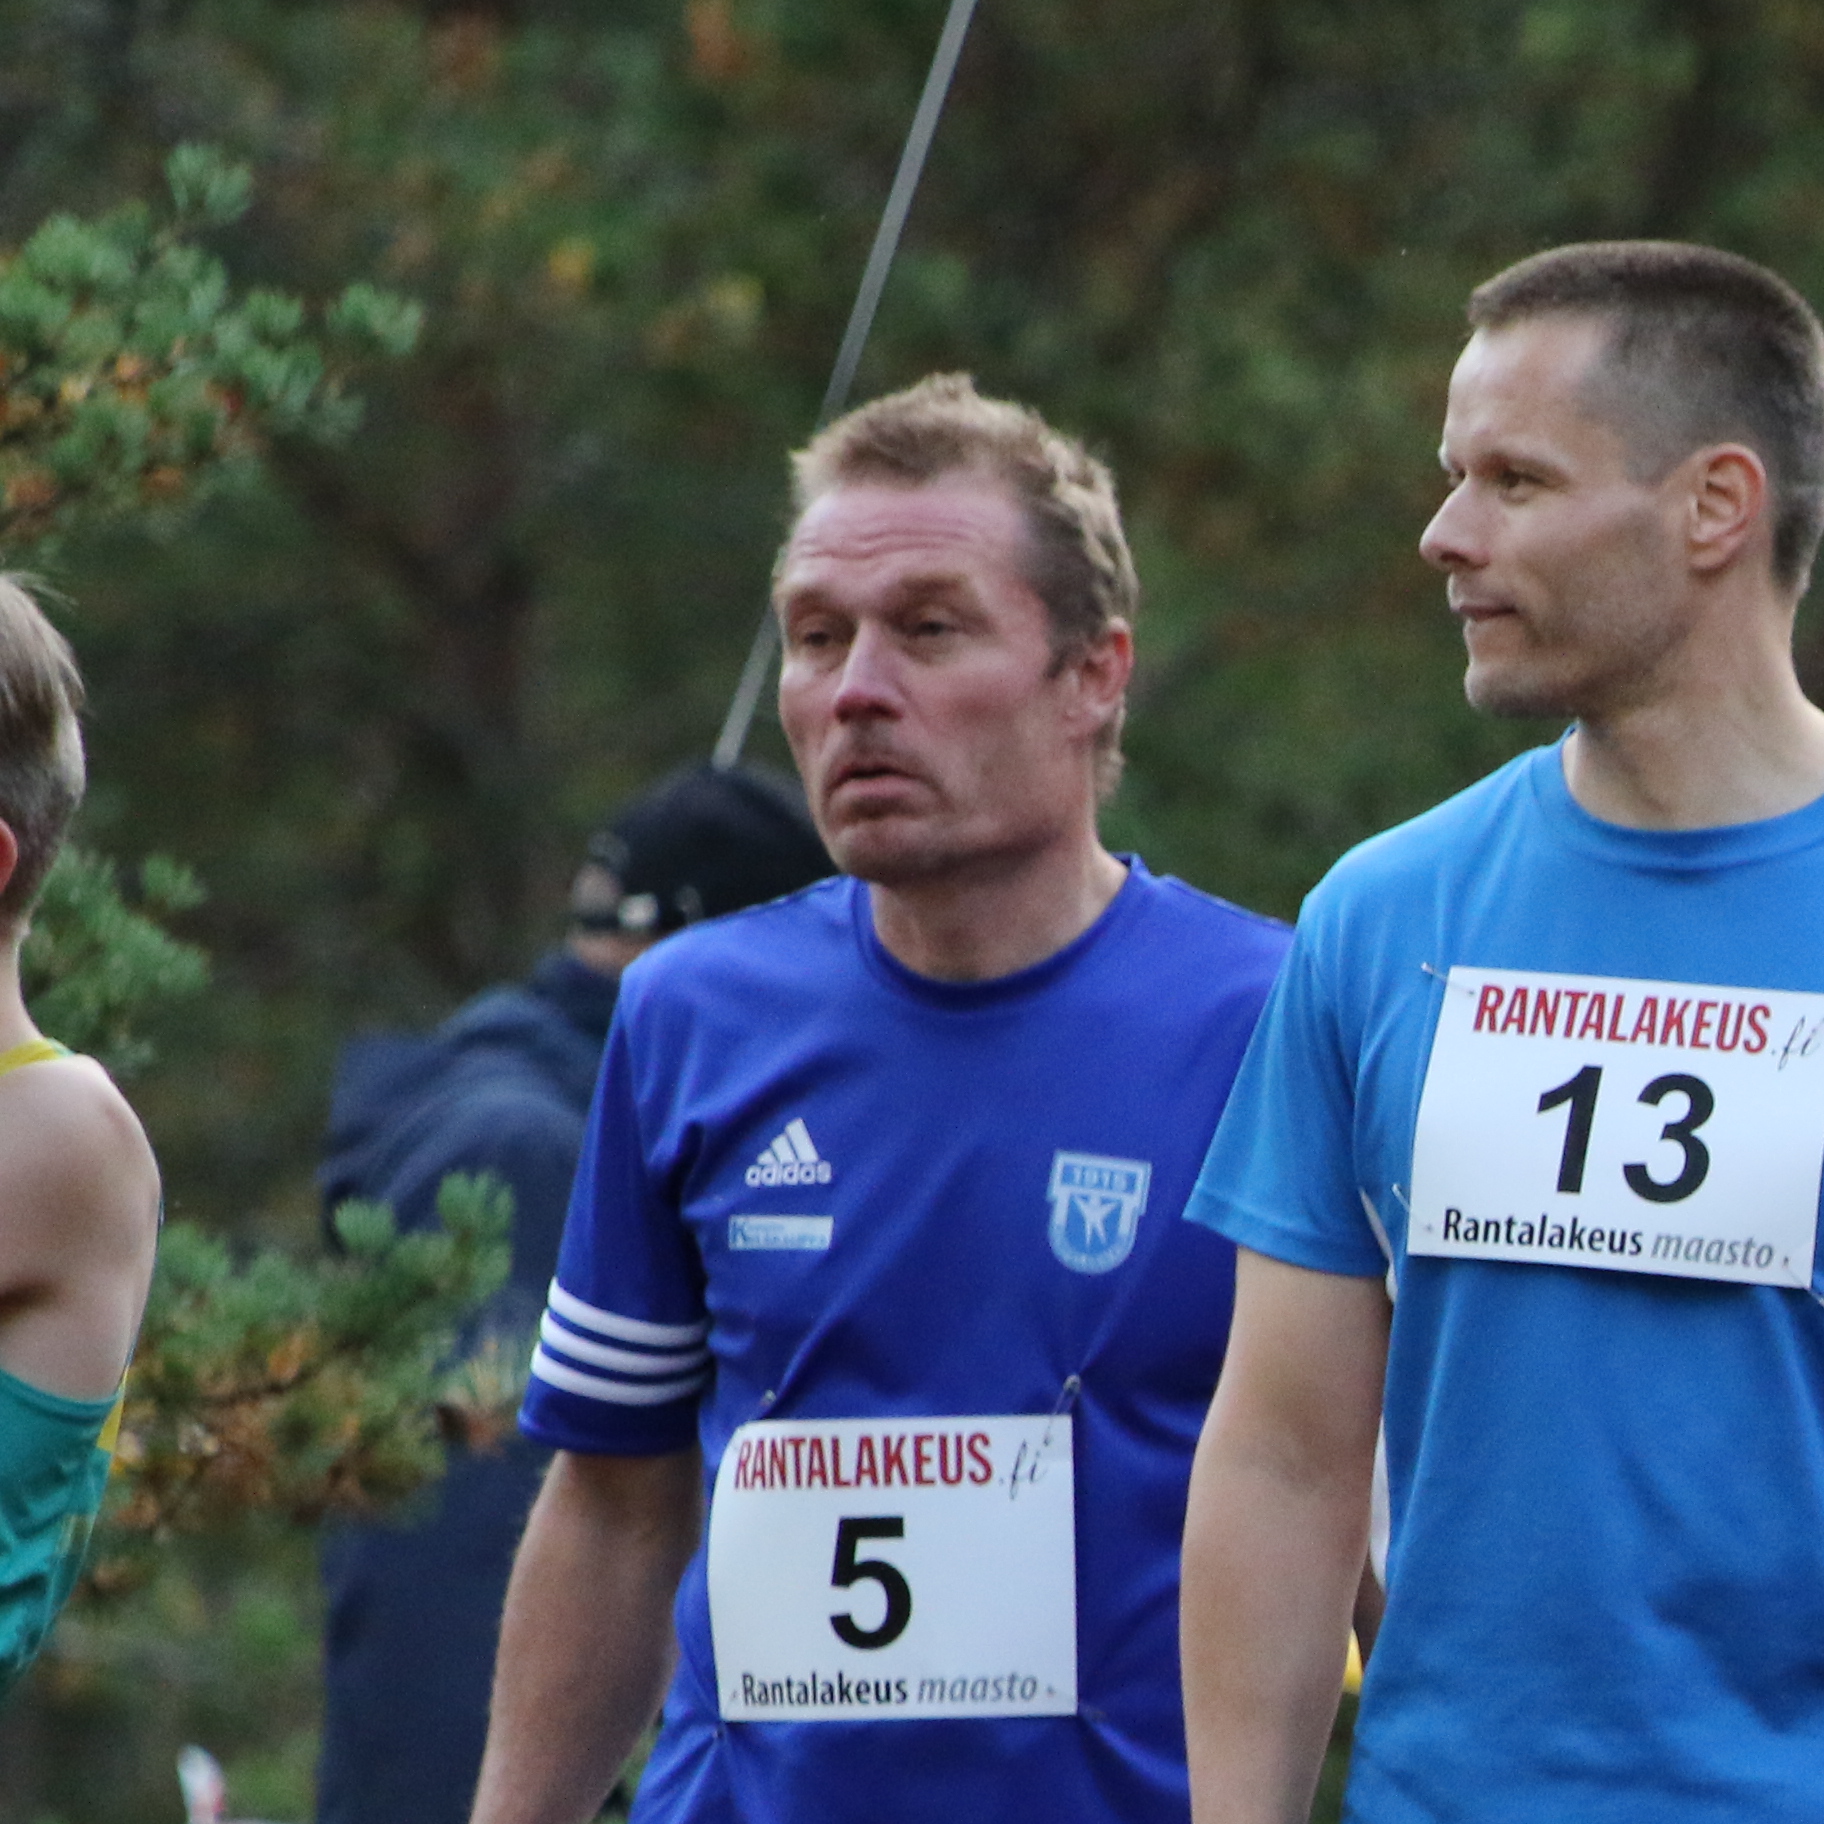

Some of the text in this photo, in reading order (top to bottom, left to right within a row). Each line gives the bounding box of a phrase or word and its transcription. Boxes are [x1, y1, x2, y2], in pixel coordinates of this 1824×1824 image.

[1474, 985, 1771, 1054] RANTALAKEUS
[1537, 1065, 1715, 1204] 13
[744, 1160, 832, 1188] adidas
[1443, 1208, 1776, 1269] Rantalakeus maasto
[735, 1432, 994, 1490] RANTALAKEUS
[829, 1516, 912, 1651] 5
[741, 1670, 1039, 1707] Rantalakeus maasto
